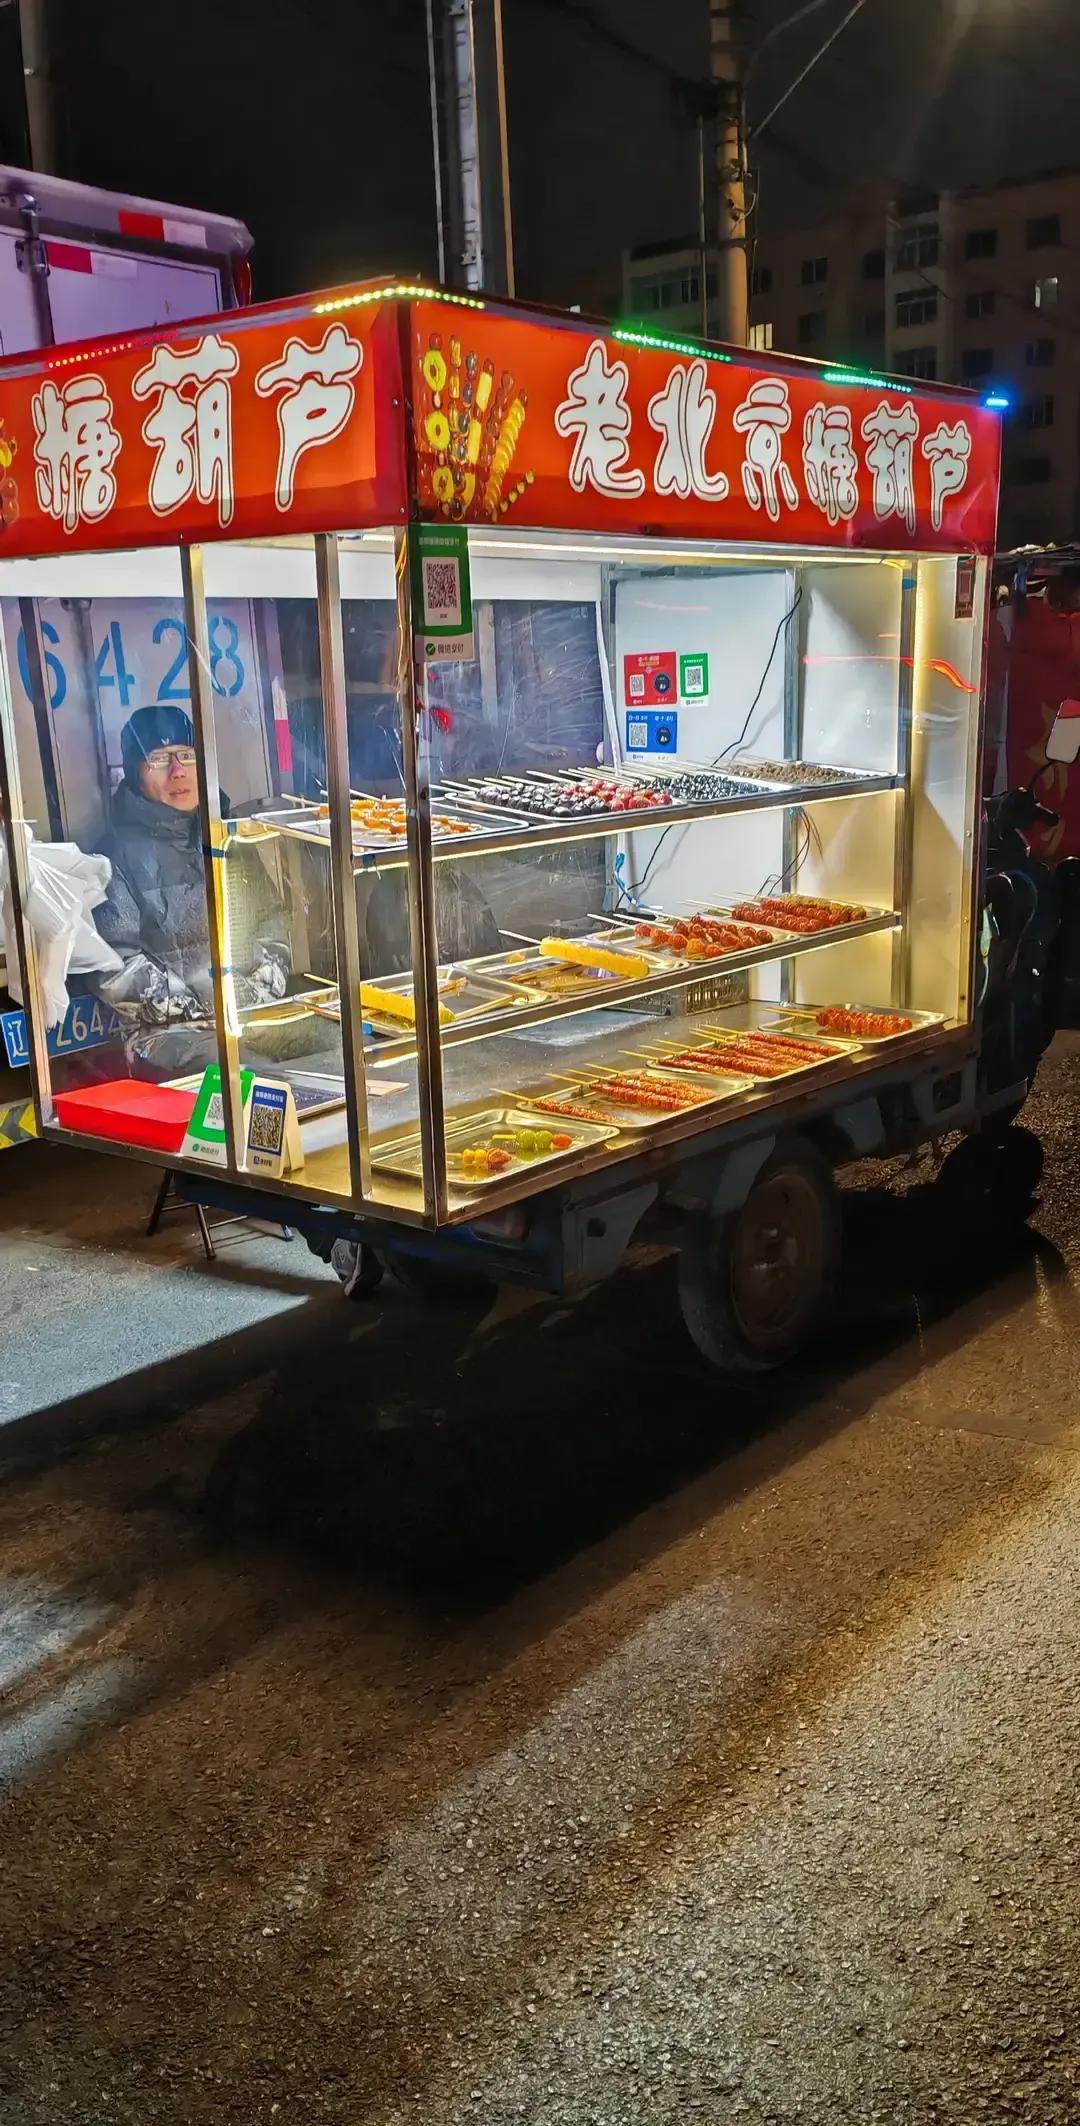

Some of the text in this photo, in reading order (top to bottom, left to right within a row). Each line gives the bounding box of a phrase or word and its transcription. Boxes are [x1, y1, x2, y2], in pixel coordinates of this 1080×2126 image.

[32, 321, 364, 535] 糖葫芦
[555, 339, 972, 537] 老北京糖葫芦
